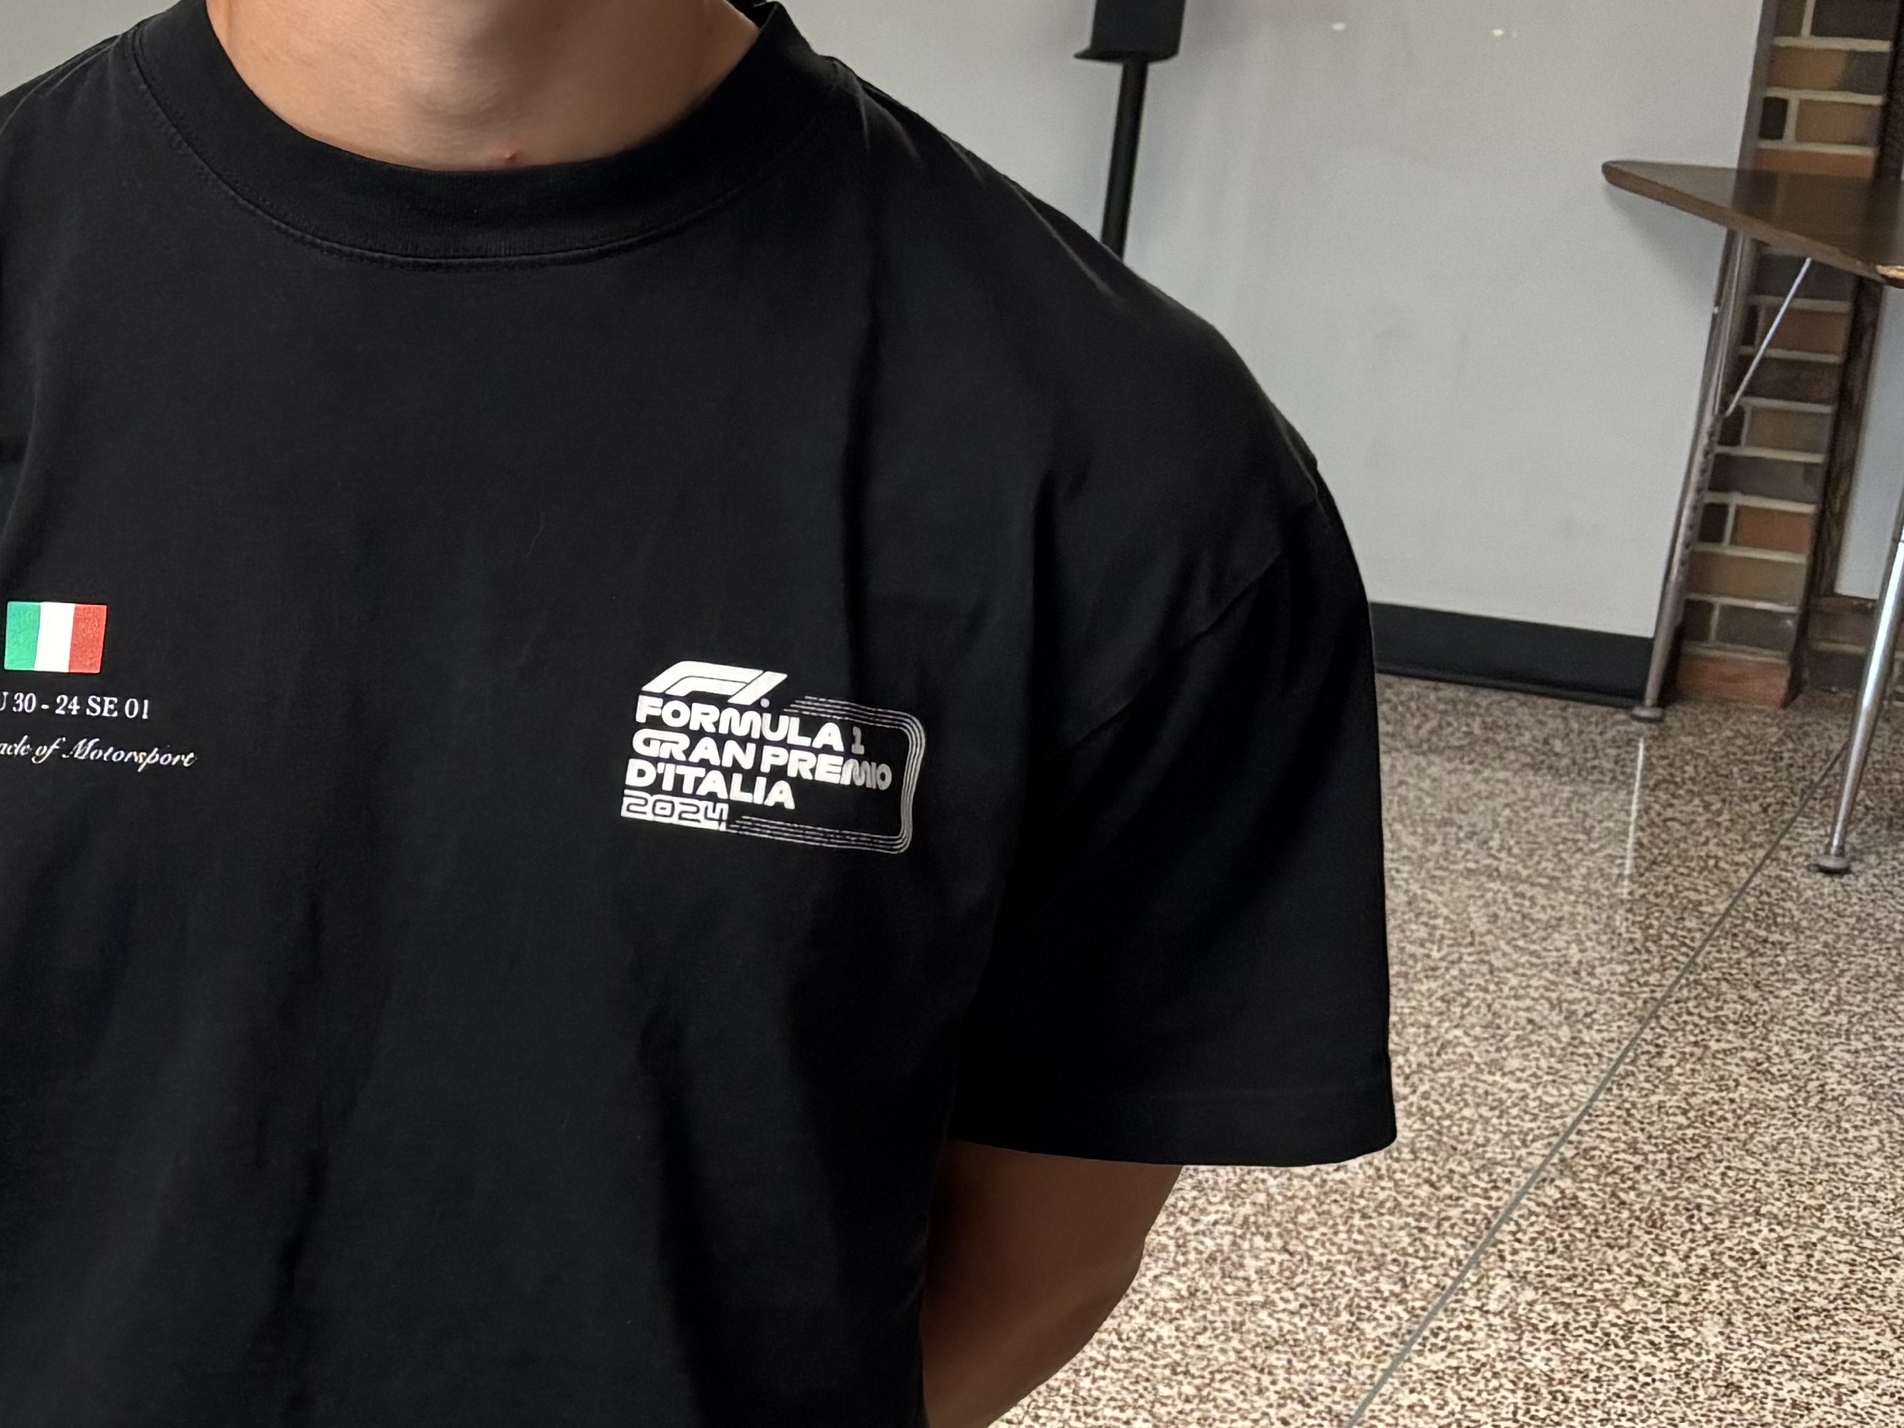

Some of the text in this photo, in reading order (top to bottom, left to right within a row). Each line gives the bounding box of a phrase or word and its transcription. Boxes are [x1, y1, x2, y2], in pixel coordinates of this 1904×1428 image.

[14, 692, 36, 713] 30
[55, 694, 80, 715] 24
[86, 695, 118, 718] SE
[124, 698, 149, 720] 01
[635, 694, 865, 754] FORMULA 1
[33, 736, 66, 764] of
[62, 738, 198, 772] Motorsport
[632, 728, 892, 791] GRAN PREMIO
[625, 758, 796, 810] D'ITALIA
[621, 789, 729, 831] 2024
